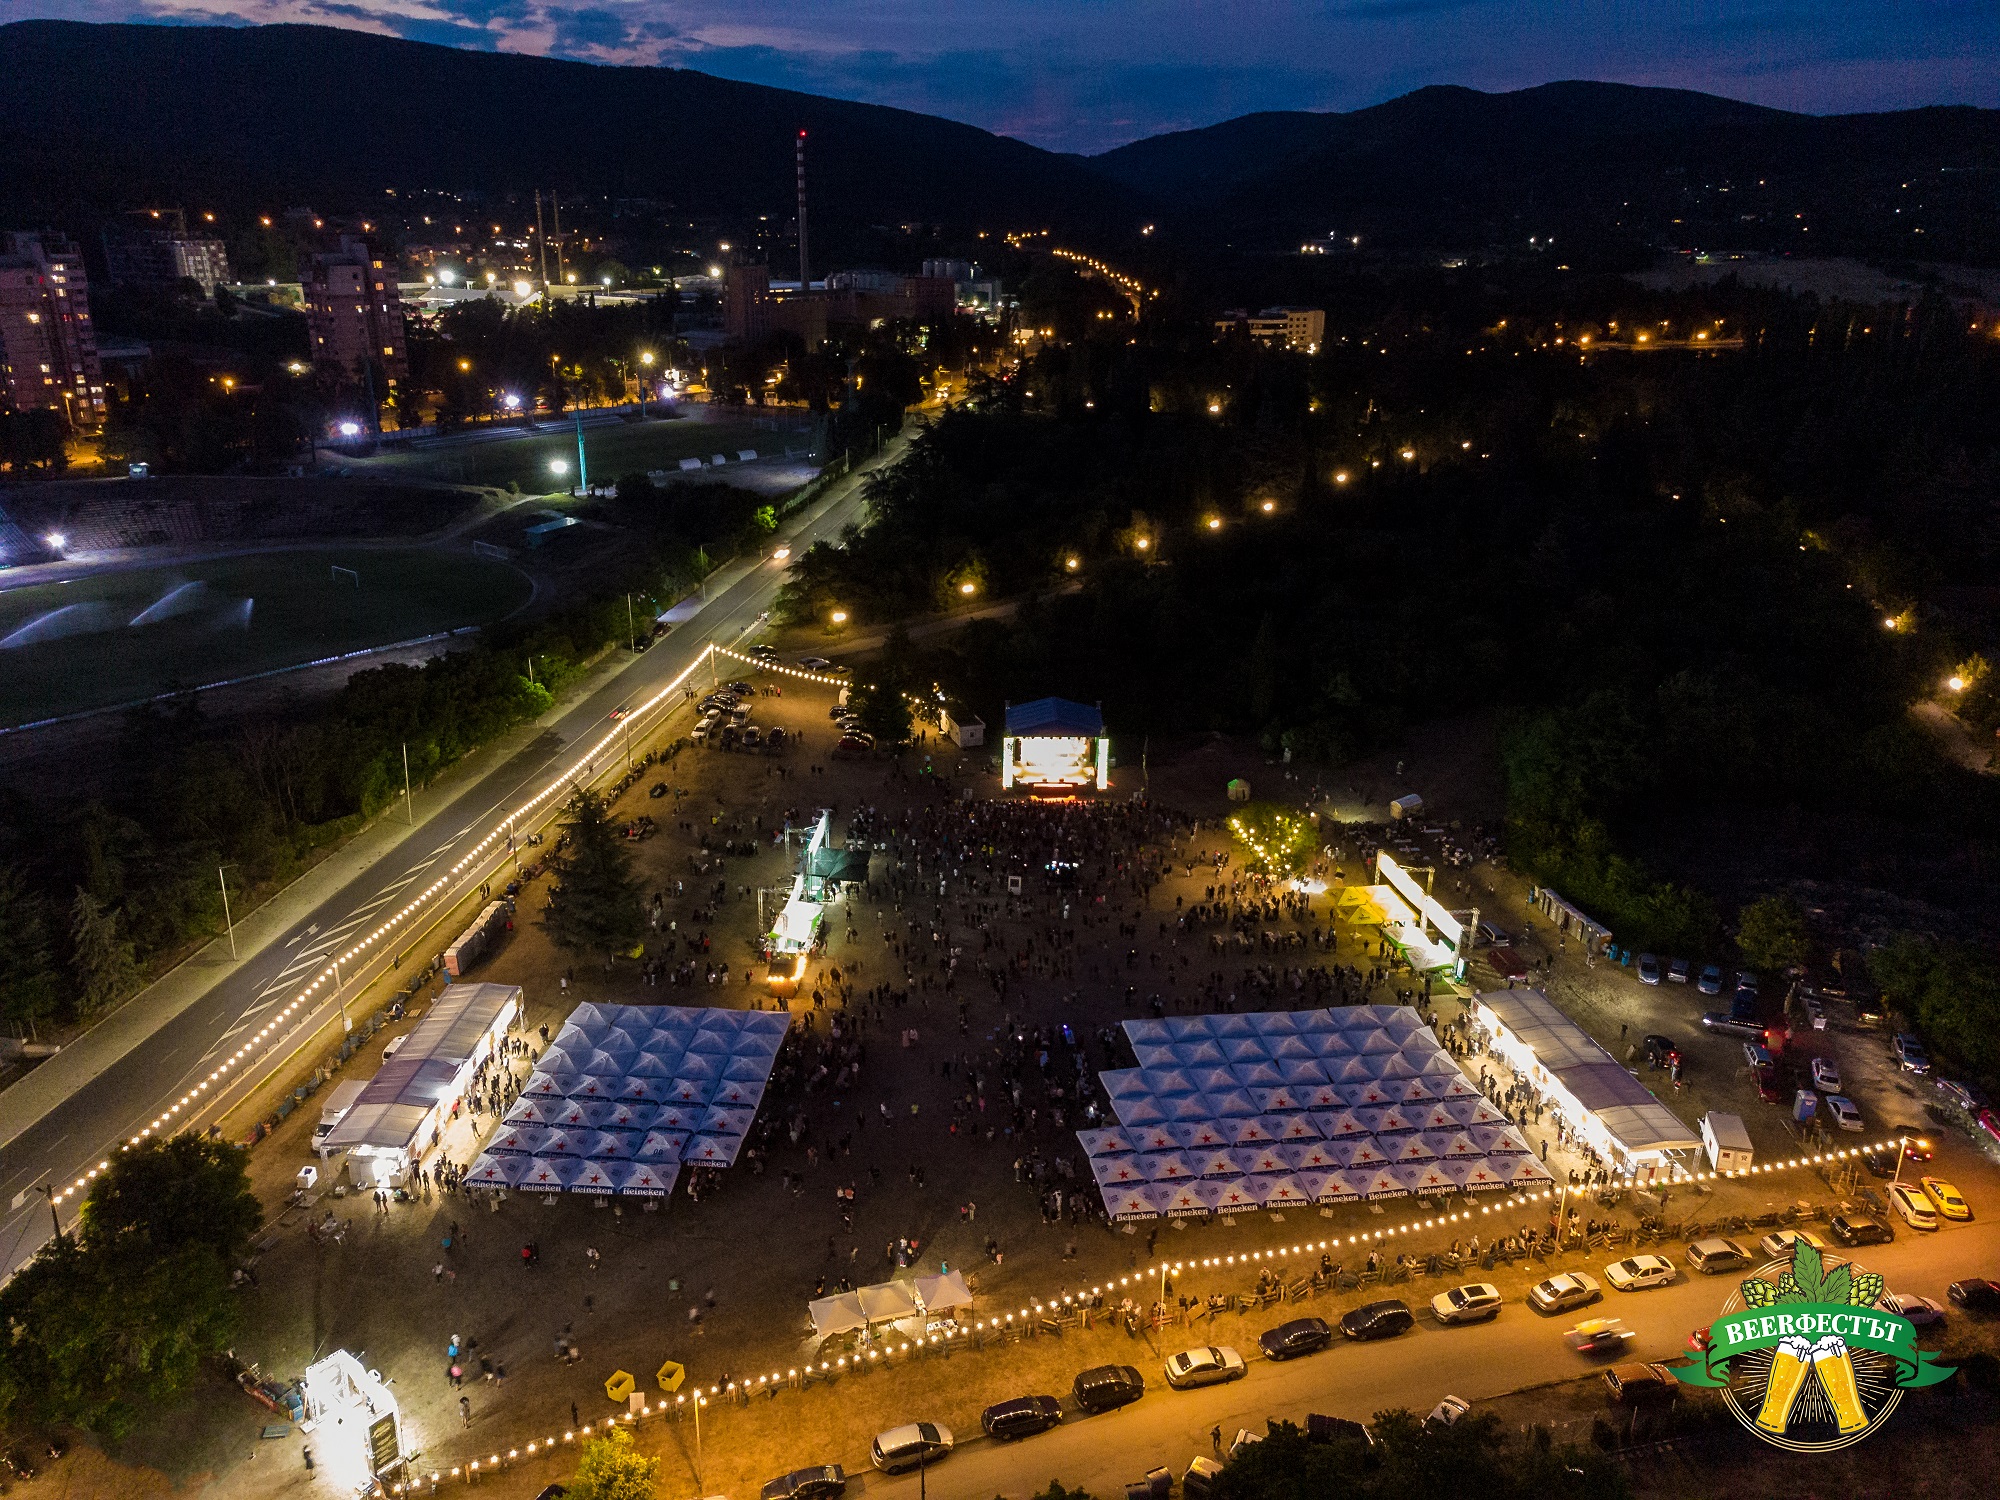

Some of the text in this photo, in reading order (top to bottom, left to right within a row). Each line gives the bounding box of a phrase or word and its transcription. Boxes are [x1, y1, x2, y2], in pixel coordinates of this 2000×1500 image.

[687, 1160, 727, 1168] Heineken
[466, 1179, 507, 1190] Heineken
[1466, 1182, 1505, 1191] Heineken
[1511, 1178, 1552, 1187] Heineken
[520, 1183, 561, 1192] Heineken
[572, 1185, 613, 1195] Heineken
[623, 1187, 664, 1196] Heineken
[1418, 1186, 1457, 1195] Heineken
[1319, 1194, 1358, 1204] Heineken
[1368, 1189, 1408, 1200] Heineken
[1266, 1199, 1307, 1208] Heineken
[1167, 1209, 1208, 1218] Heineken
[1217, 1204, 1258, 1214] Heineken
[1116, 1212, 1157, 1221] Heineken
